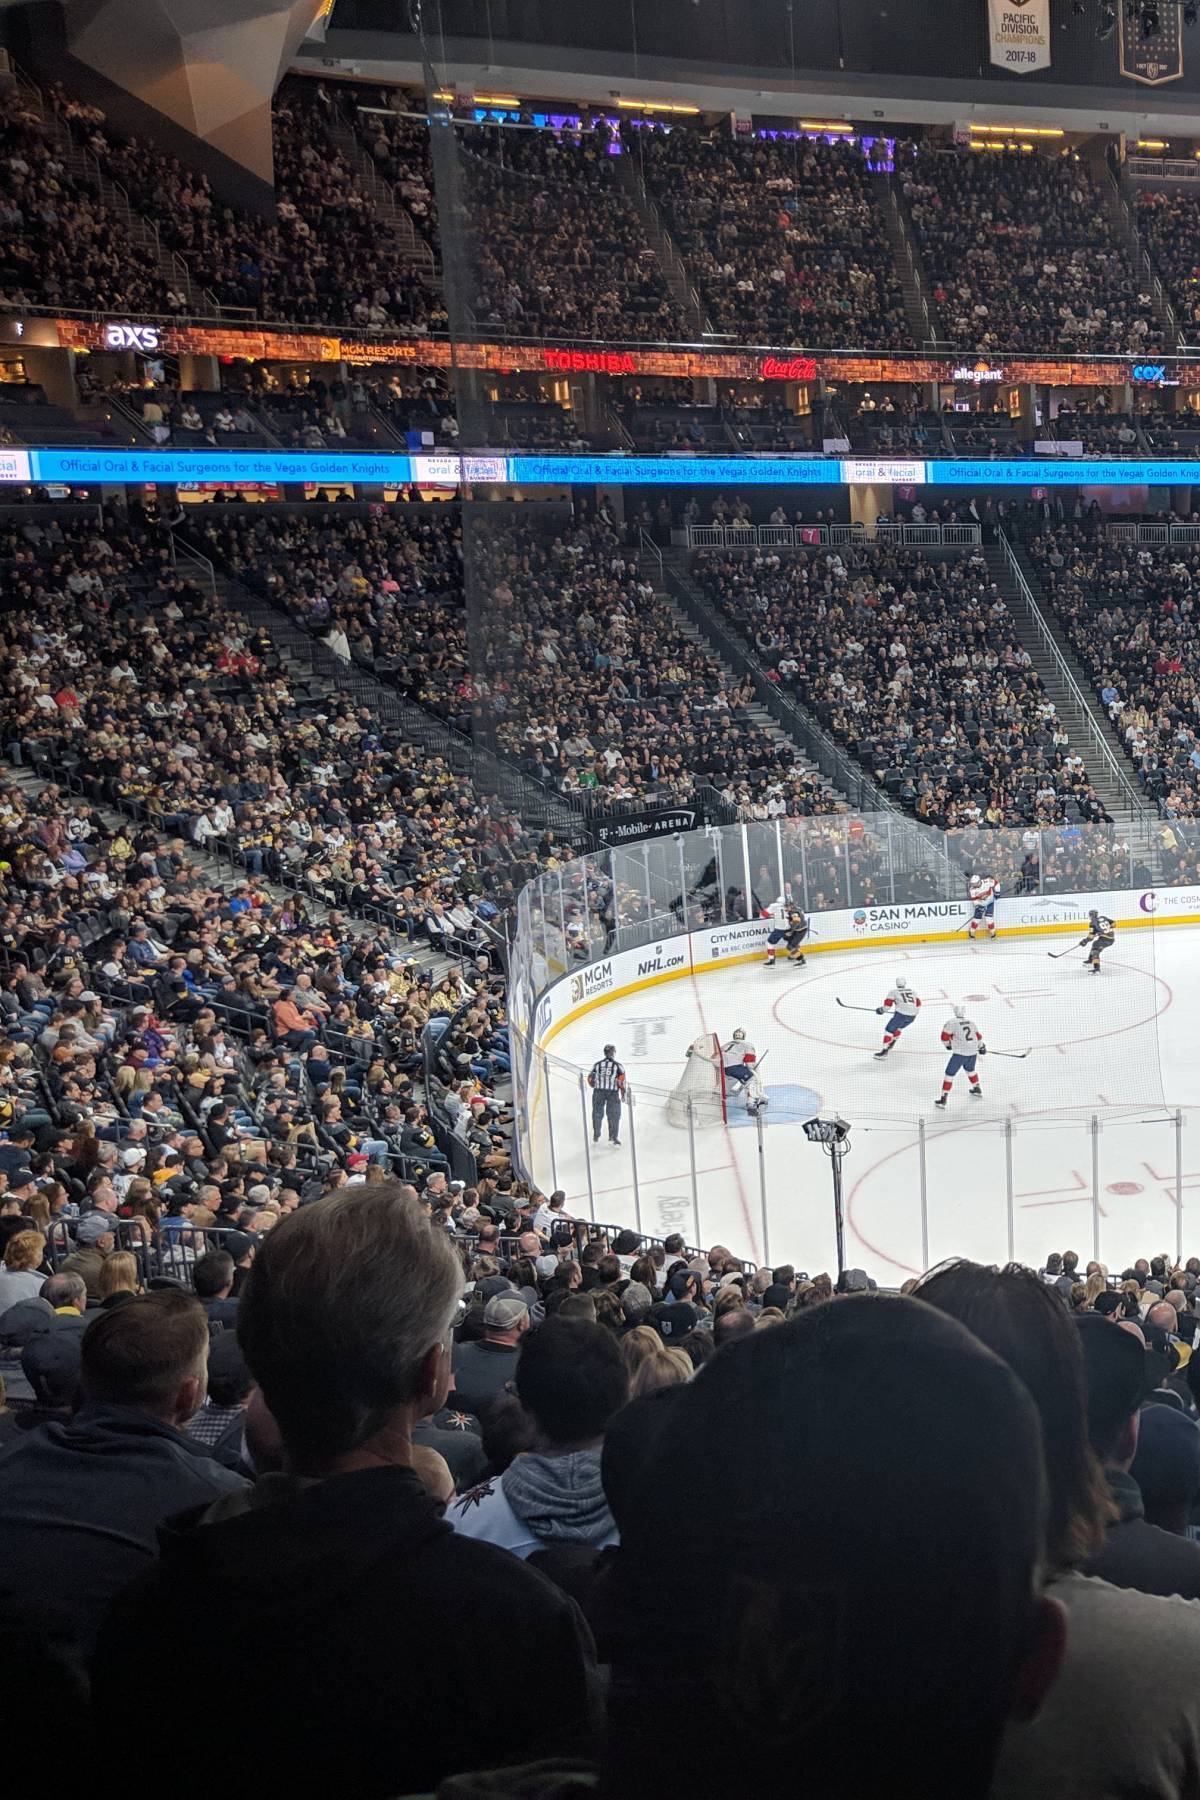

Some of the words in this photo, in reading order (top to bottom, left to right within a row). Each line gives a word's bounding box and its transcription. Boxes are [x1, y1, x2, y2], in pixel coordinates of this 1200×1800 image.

[1003, 13, 1036, 25] PACIFIC
[1001, 23, 1039, 35] DIVISION
[995, 32, 1046, 45] CHAMPIONS
[1006, 50, 1036, 63] 2017-18
[106, 324, 158, 351] axs
[340, 344, 367, 355] MGM
[367, 346, 416, 357] RESORTS
[543, 348, 636, 372] TOSHIBA
[953, 366, 1003, 382] allegiant
[60, 459, 101, 472] Official
[104, 459, 128, 472] Oral
[131, 460, 139, 472] &
[143, 460, 174, 472] Facial
[177, 460, 231, 475] Surgeons
[234, 460, 250, 472] for
[254, 462, 272, 474] the
[275, 463, 307, 477] Vegas
[312, 462, 348, 474] Golden
[352, 463, 390, 477] Knights
[428, 466, 451, 475] oral
[454, 465, 461, 475] &
[877, 468, 887, 477] &
[949, 466, 982, 478] Official
[984, 467, 1004, 478] Oral
[1006, 468, 1013, 478] &
[1015, 468, 1041, 478] Facial
[1043, 467, 1084, 480] Surgeons
[1086, 467, 1099, 478] for
[1102, 468, 1117, 479] the
[1119, 468, 1145, 480] Vegas
[1147, 467, 1178, 478] Golden
[654, 817, 689, 831] ARENA
[1164, 896, 1178, 905] THE
[869, 908, 899, 922] SAN
[904, 904, 966, 919] MANUEL
[1021, 912, 1060, 924] CHALK
[1063, 910, 1088, 922] HILL
[869, 921, 910, 932] CASINO
[710, 931, 728, 945] CITY
[729, 926, 772, 942] NATIONAL
[584, 961, 612, 985] MGM
[585, 977, 613, 997] RESORTS
[900, 992, 914, 1004] 15
[962, 1026, 973, 1041] 2
